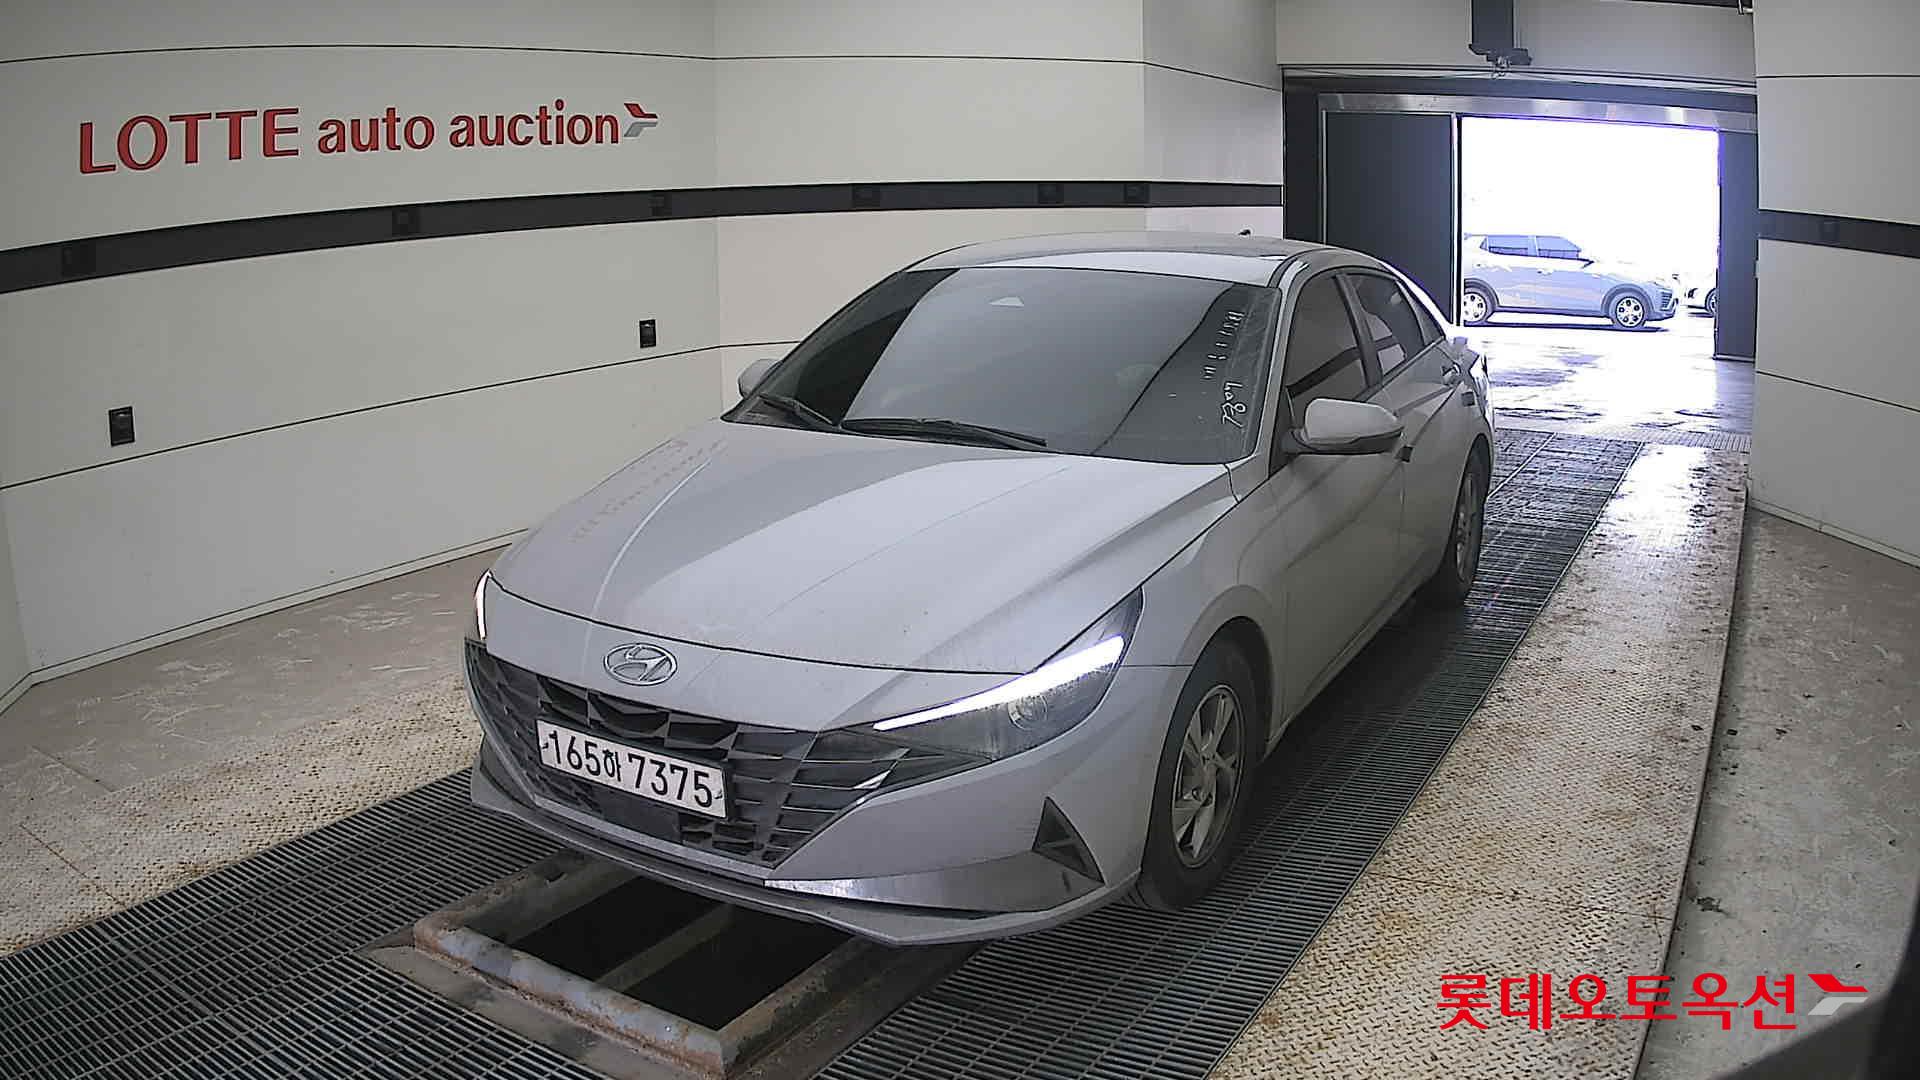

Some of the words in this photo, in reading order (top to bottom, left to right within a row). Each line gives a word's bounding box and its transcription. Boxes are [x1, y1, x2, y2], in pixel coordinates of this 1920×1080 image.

[79, 107, 300, 174] LOTTE
[317, 107, 436, 154] auto
[449, 99, 620, 148] auction
